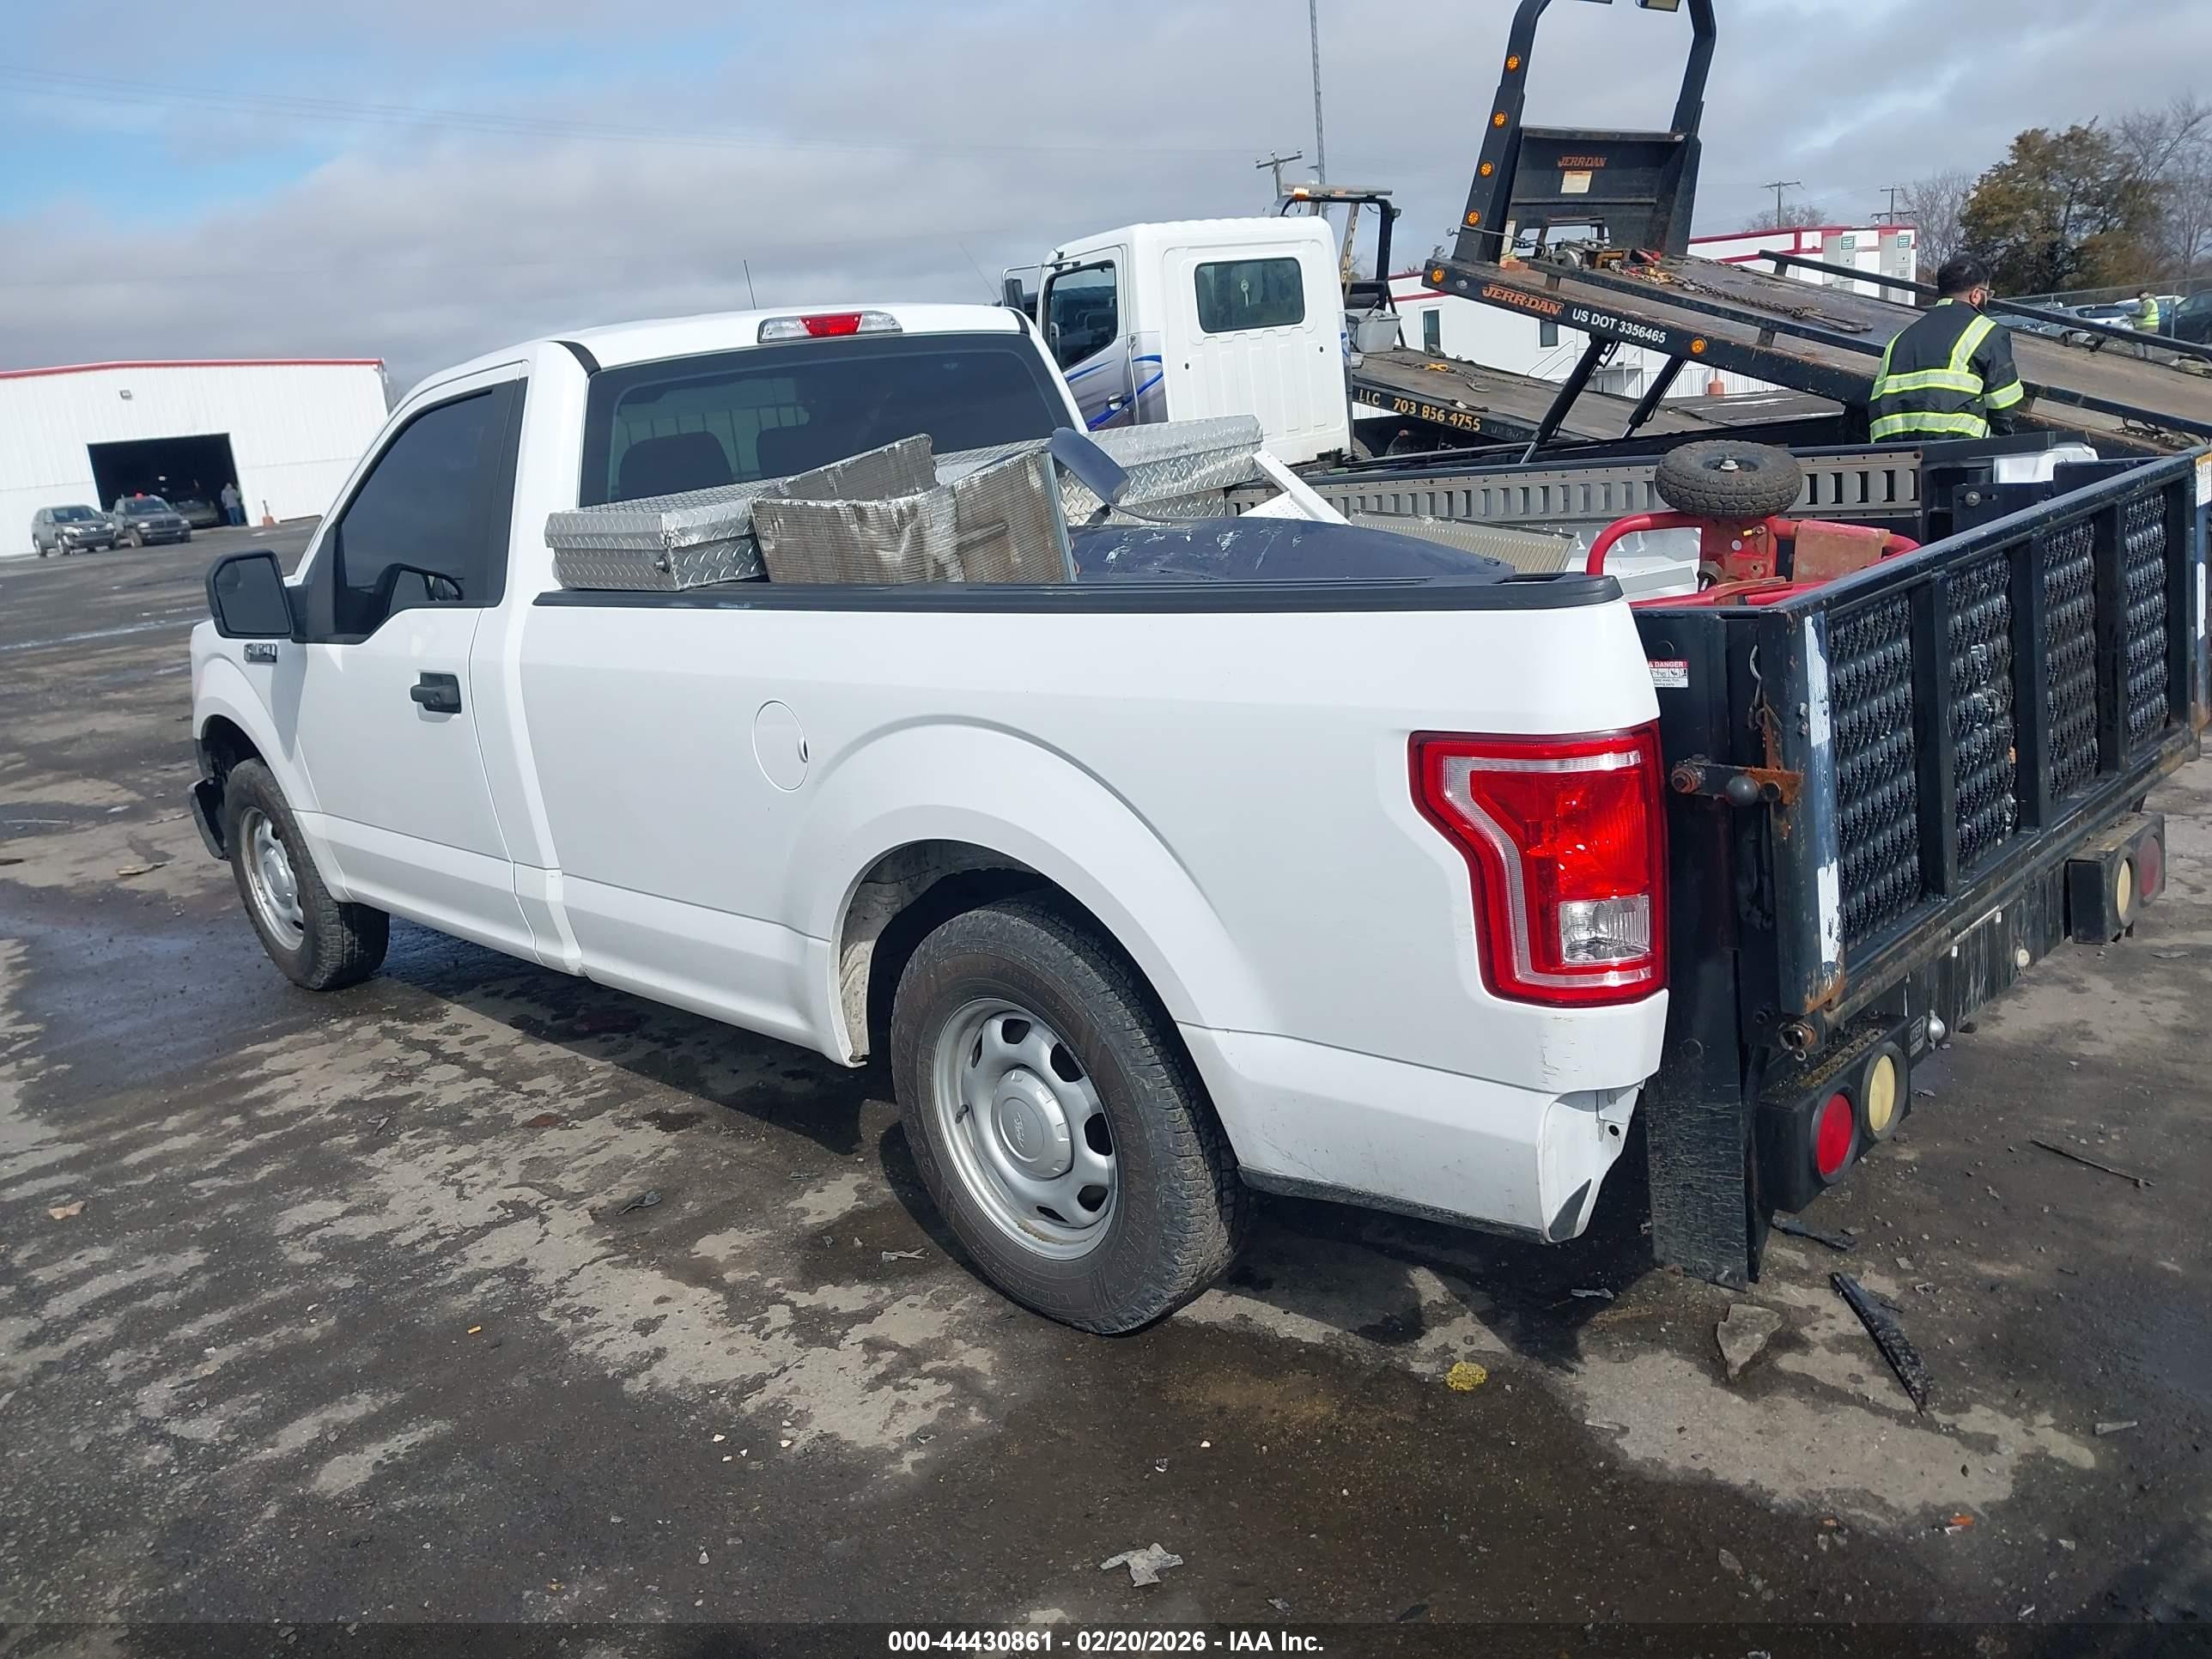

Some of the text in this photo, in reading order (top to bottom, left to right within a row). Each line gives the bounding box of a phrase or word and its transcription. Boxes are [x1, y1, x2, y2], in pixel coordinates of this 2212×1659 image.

[1572, 308, 1667, 343] US DOT 3356465
[1358, 389, 1481, 432] LLC 703 856 4755
